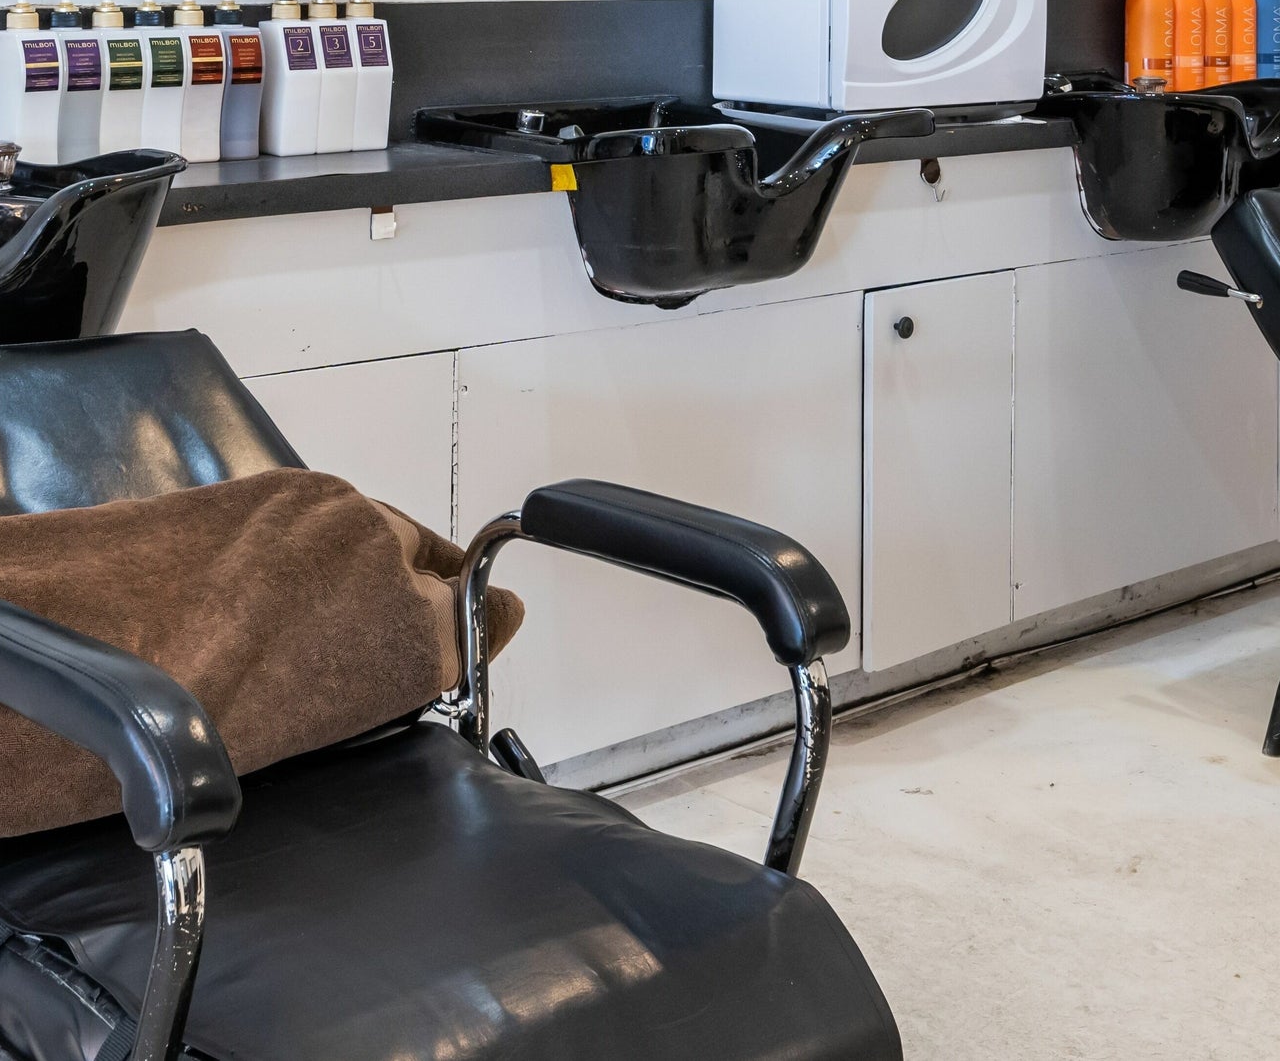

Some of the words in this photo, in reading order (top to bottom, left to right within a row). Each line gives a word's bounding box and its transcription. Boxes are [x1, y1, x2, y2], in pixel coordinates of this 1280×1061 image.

[332, 38, 340, 50] 3
[368, 36, 376, 48] 5
[1191, 7, 1202, 54] LOMA
[1215, 7, 1228, 54] LOMA
[1243, 7, 1255, 53] LOMA
[296, 39, 304, 51] 2
